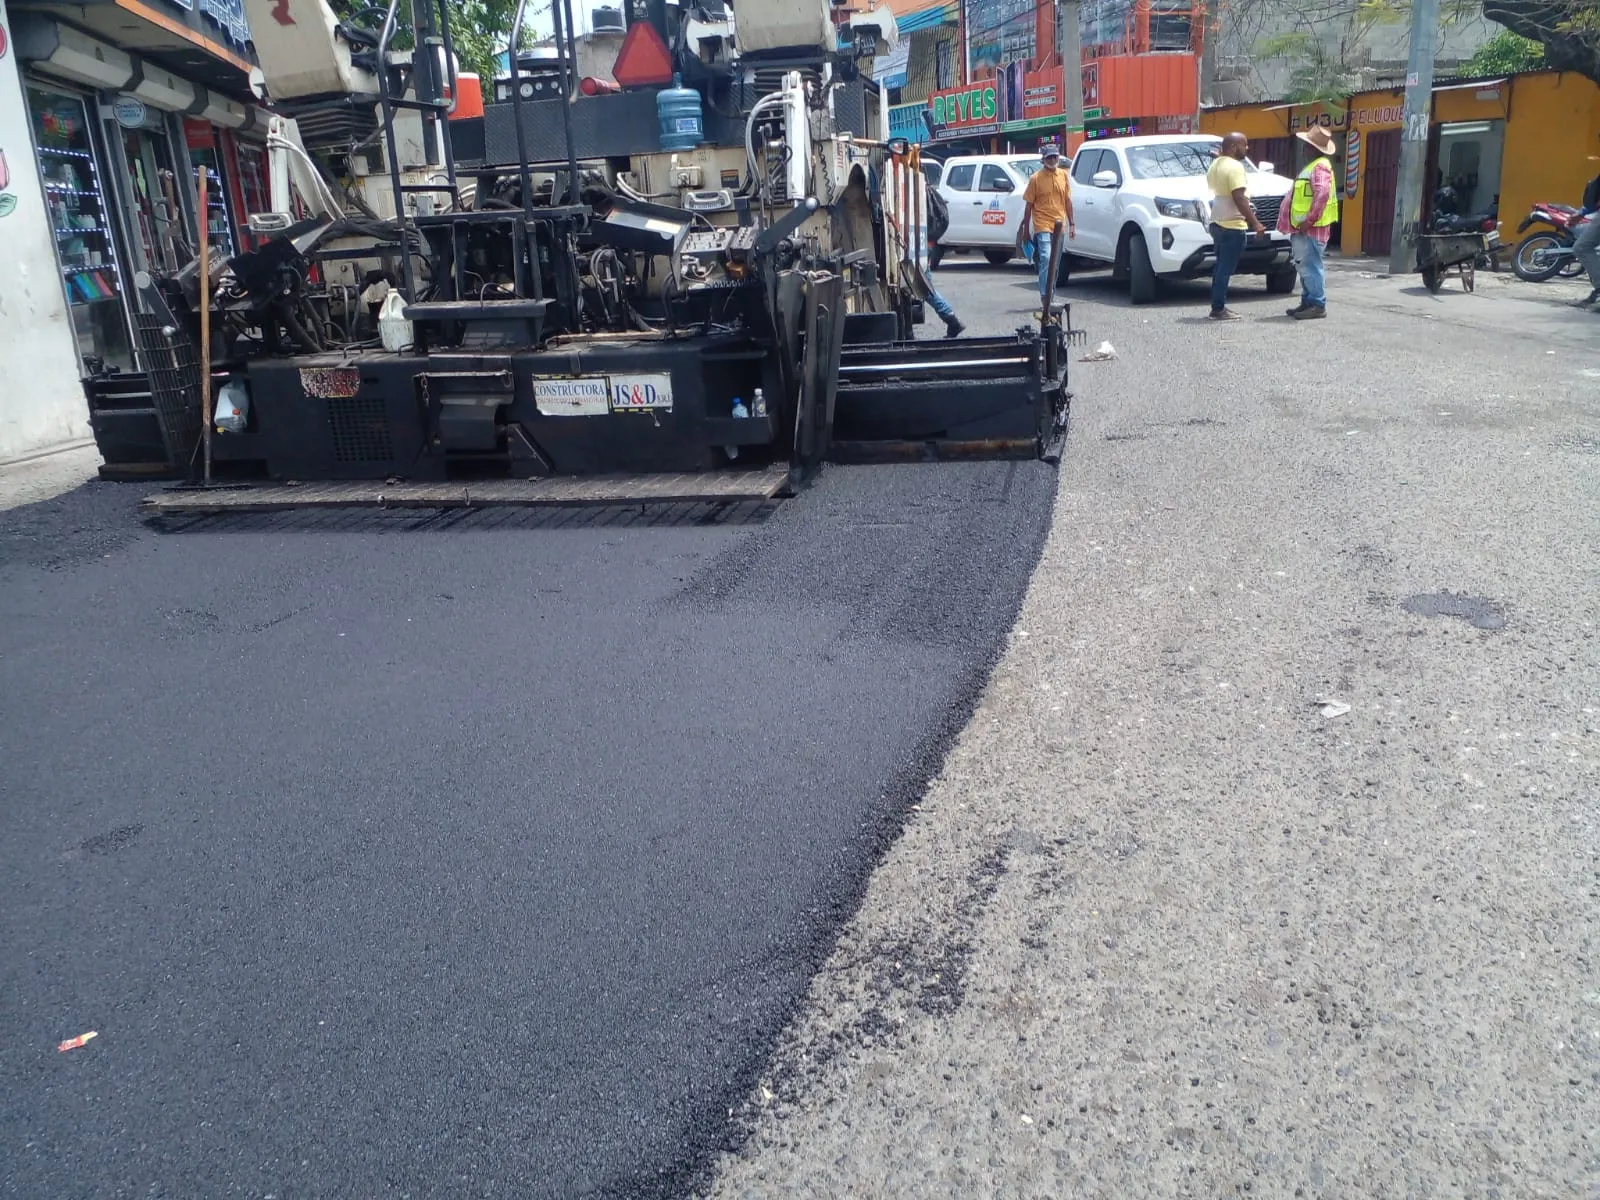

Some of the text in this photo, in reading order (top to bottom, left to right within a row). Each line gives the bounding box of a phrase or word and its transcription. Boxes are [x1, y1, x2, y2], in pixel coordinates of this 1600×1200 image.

[934, 88, 995, 125] REYES
[983, 213, 1004, 223] MOPC
[535, 383, 605, 397] CONSTRUCTORA
[614, 383, 657, 406] JS&D
